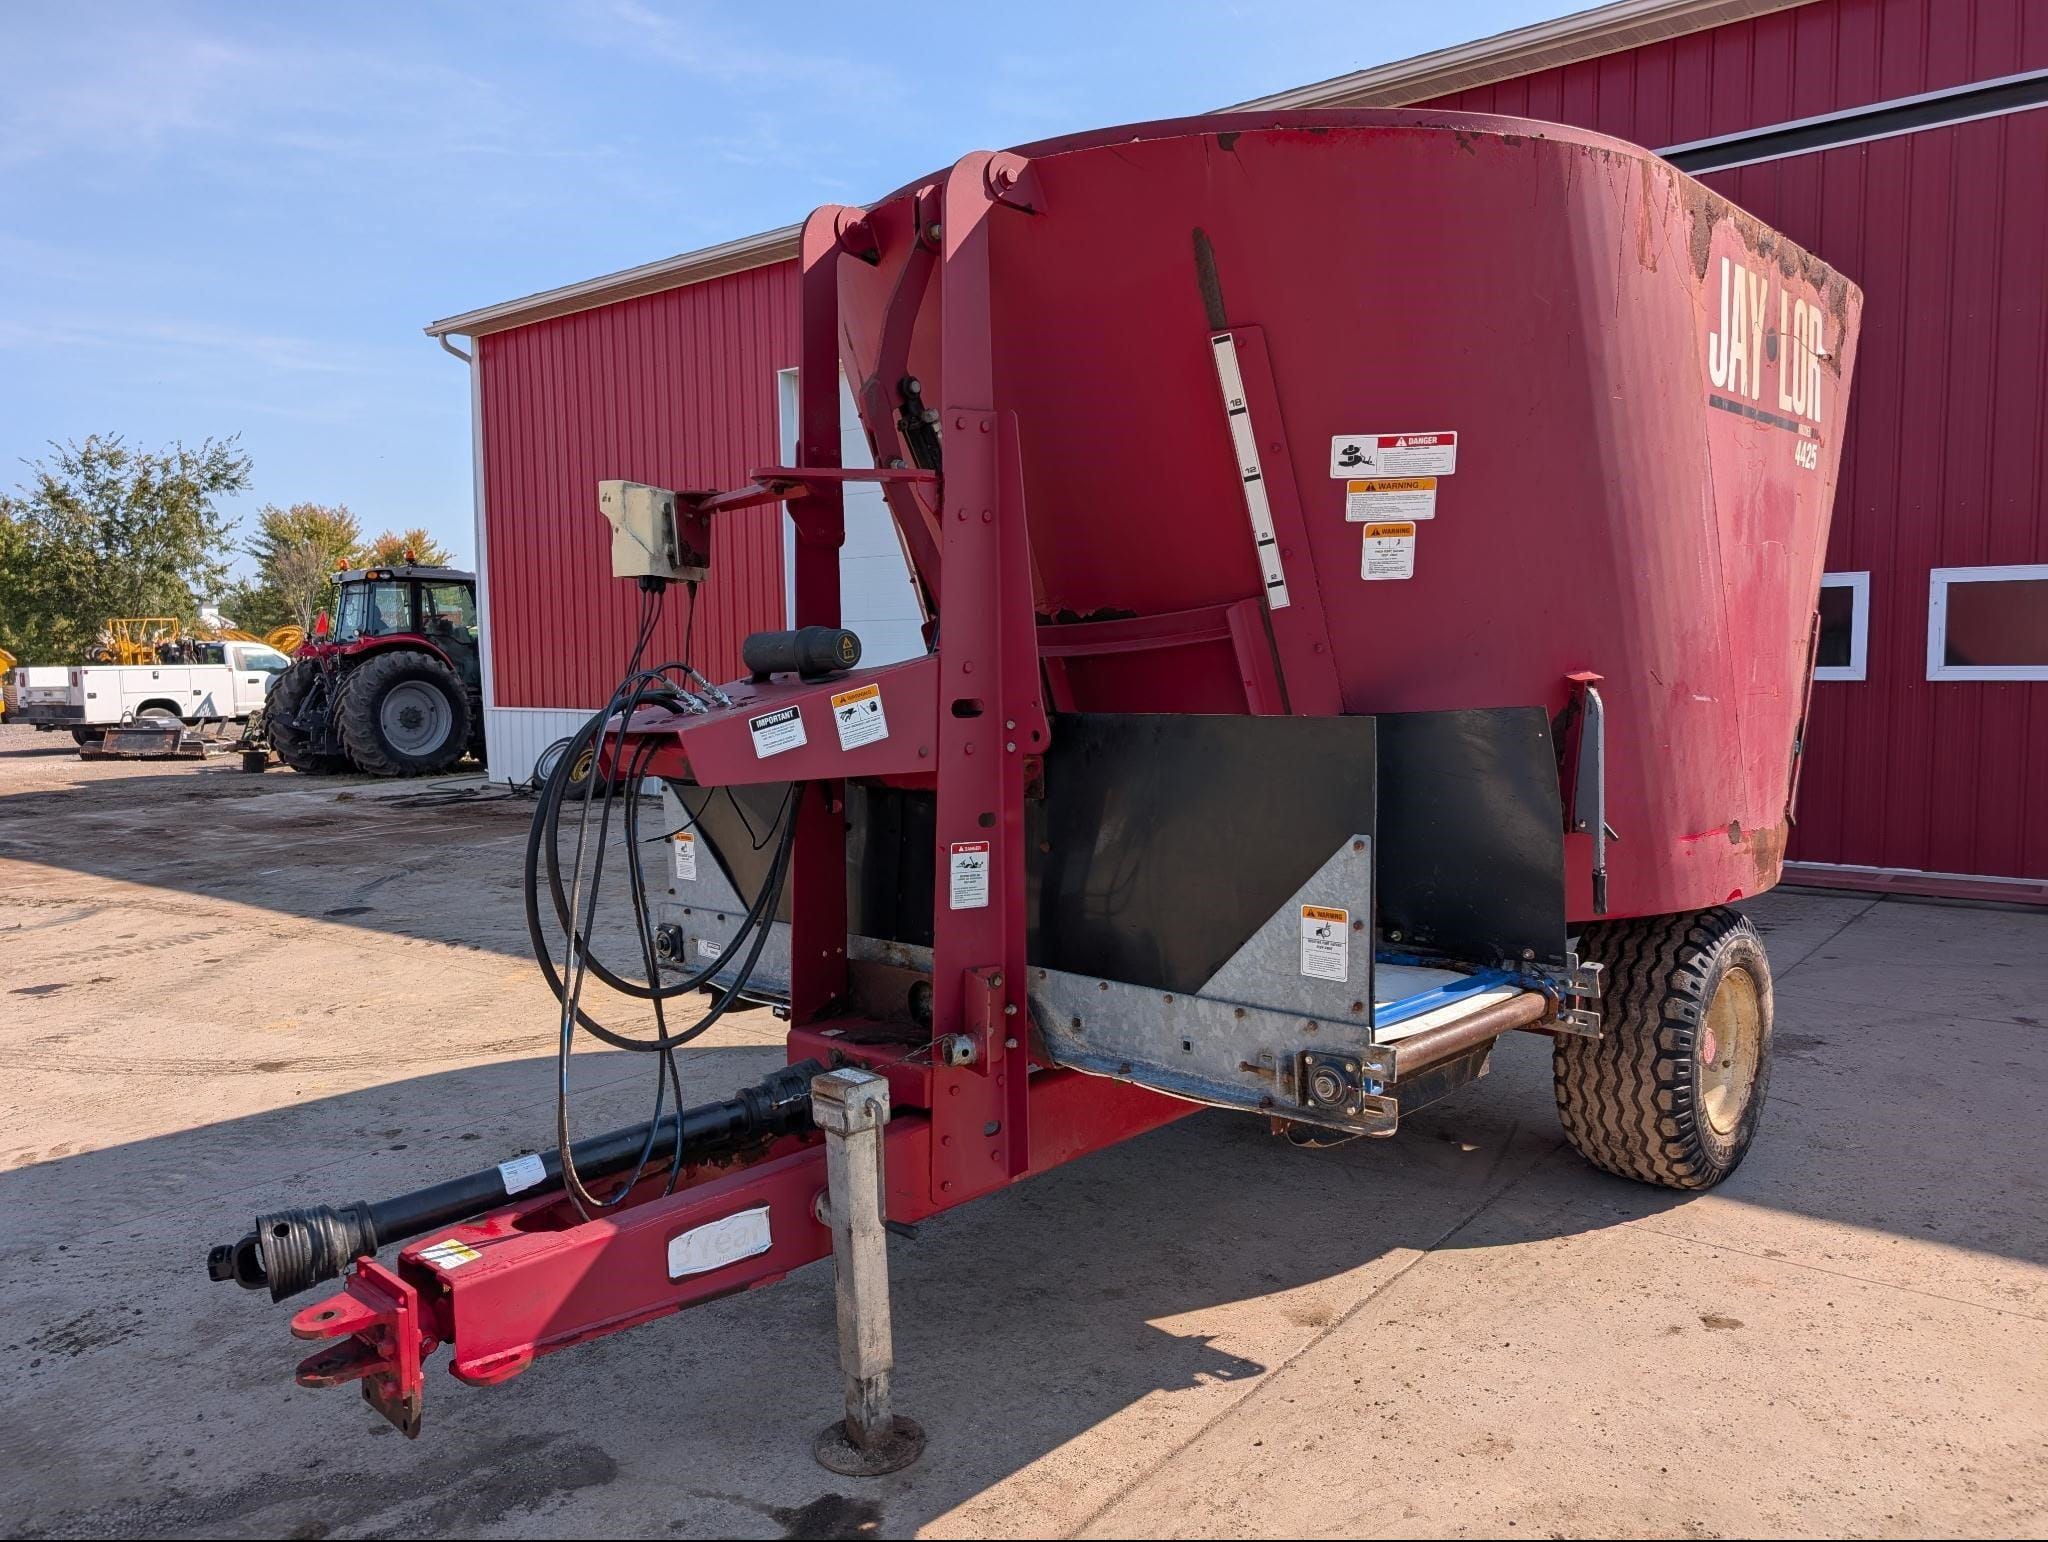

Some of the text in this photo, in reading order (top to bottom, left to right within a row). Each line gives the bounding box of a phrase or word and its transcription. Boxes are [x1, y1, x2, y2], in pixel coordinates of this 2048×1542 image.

[1709, 256, 1768, 401] JAY
[1230, 398, 1242, 408] 18
[1408, 436, 1438, 446] DANGER
[1795, 440, 1817, 470] 4425
[1245, 466, 1257, 474] 12
[1378, 482, 1419, 490] WARNING
[1382, 527, 1411, 535] WARNING
[756, 710, 794, 728] IMPORTANT
[1317, 911, 1343, 921] WARNING
